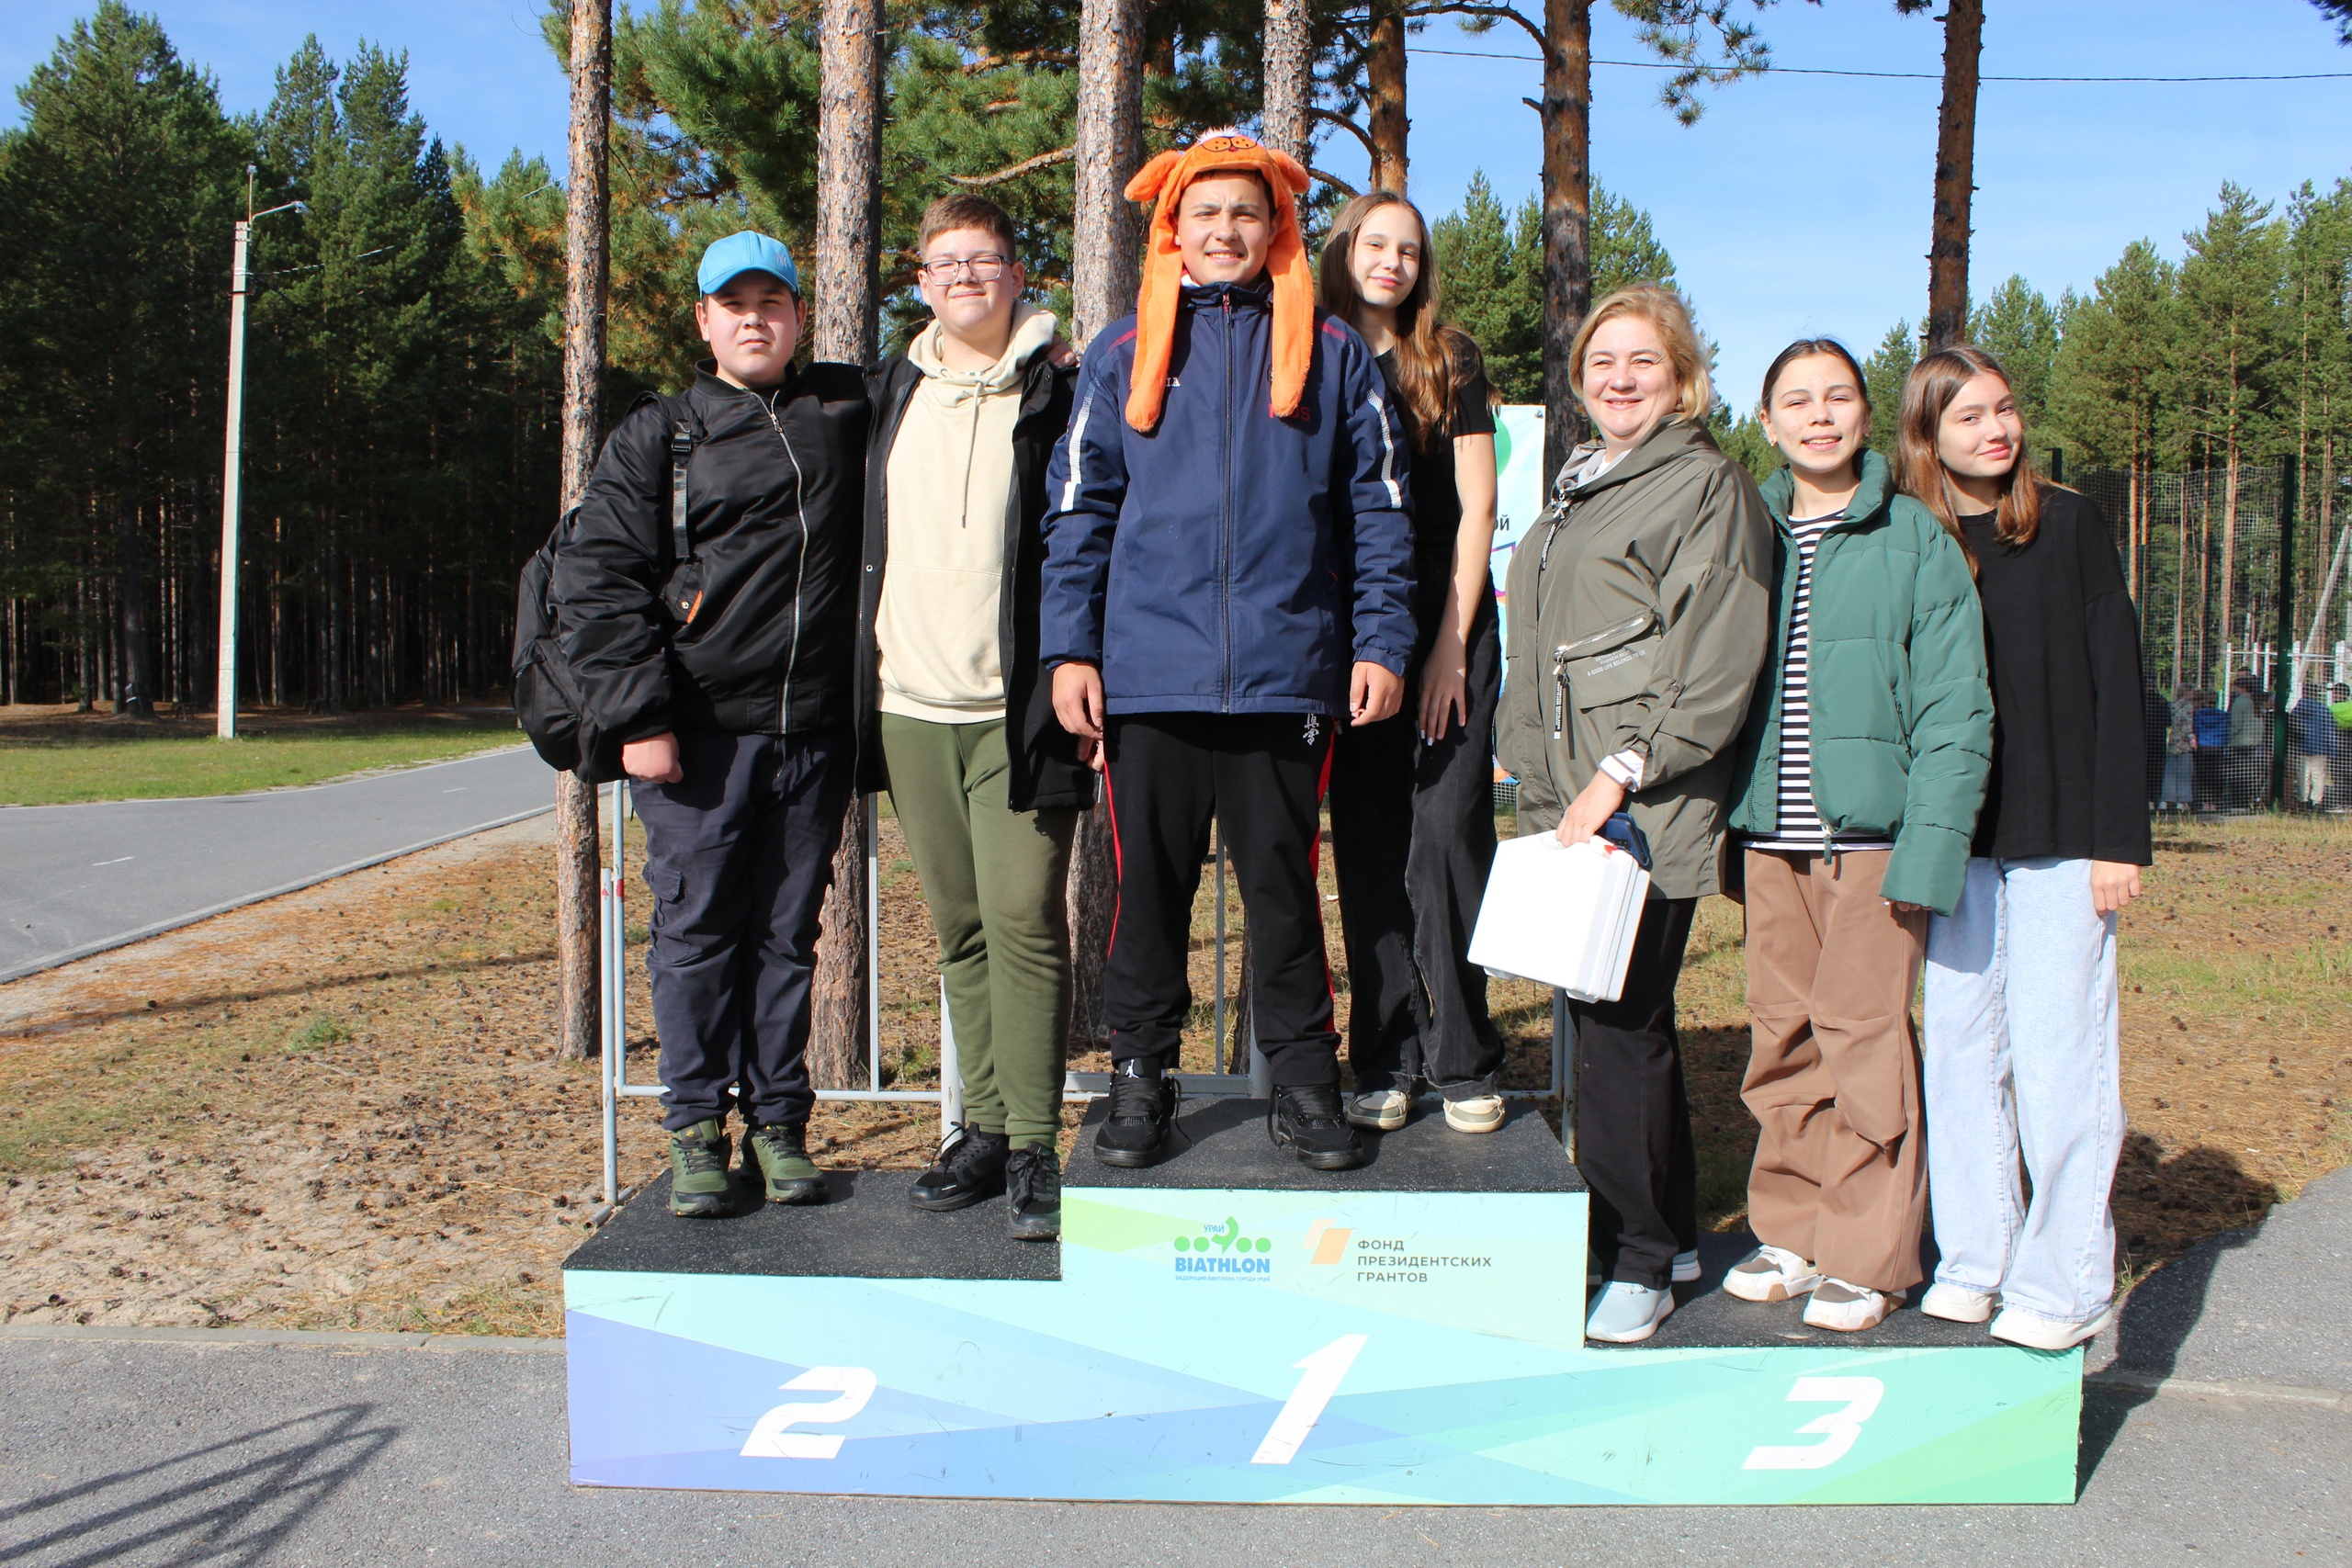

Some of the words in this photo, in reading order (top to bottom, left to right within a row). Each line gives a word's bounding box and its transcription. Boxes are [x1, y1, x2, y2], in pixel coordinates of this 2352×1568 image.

[1590, 666, 1604, 675] GOOD
[1603, 662, 1613, 671] LIFE
[1612, 654, 1633, 667] BELONGS
[1600, 655, 1619, 665] FASHION
[1204, 1223, 1225, 1233] УРАЙ
[1358, 1239, 1405, 1252] ФОНД
[1175, 1257, 1270, 1273] BIATHLON
[1357, 1256, 1492, 1269] ПРЕЗИДЕНТСКИХ
[1357, 1272, 1428, 1282] ГРАНТОВ
[1251, 1334, 1368, 1464] 1
[741, 1366, 876, 1459] 2
[1743, 1377, 1884, 1470] 3
